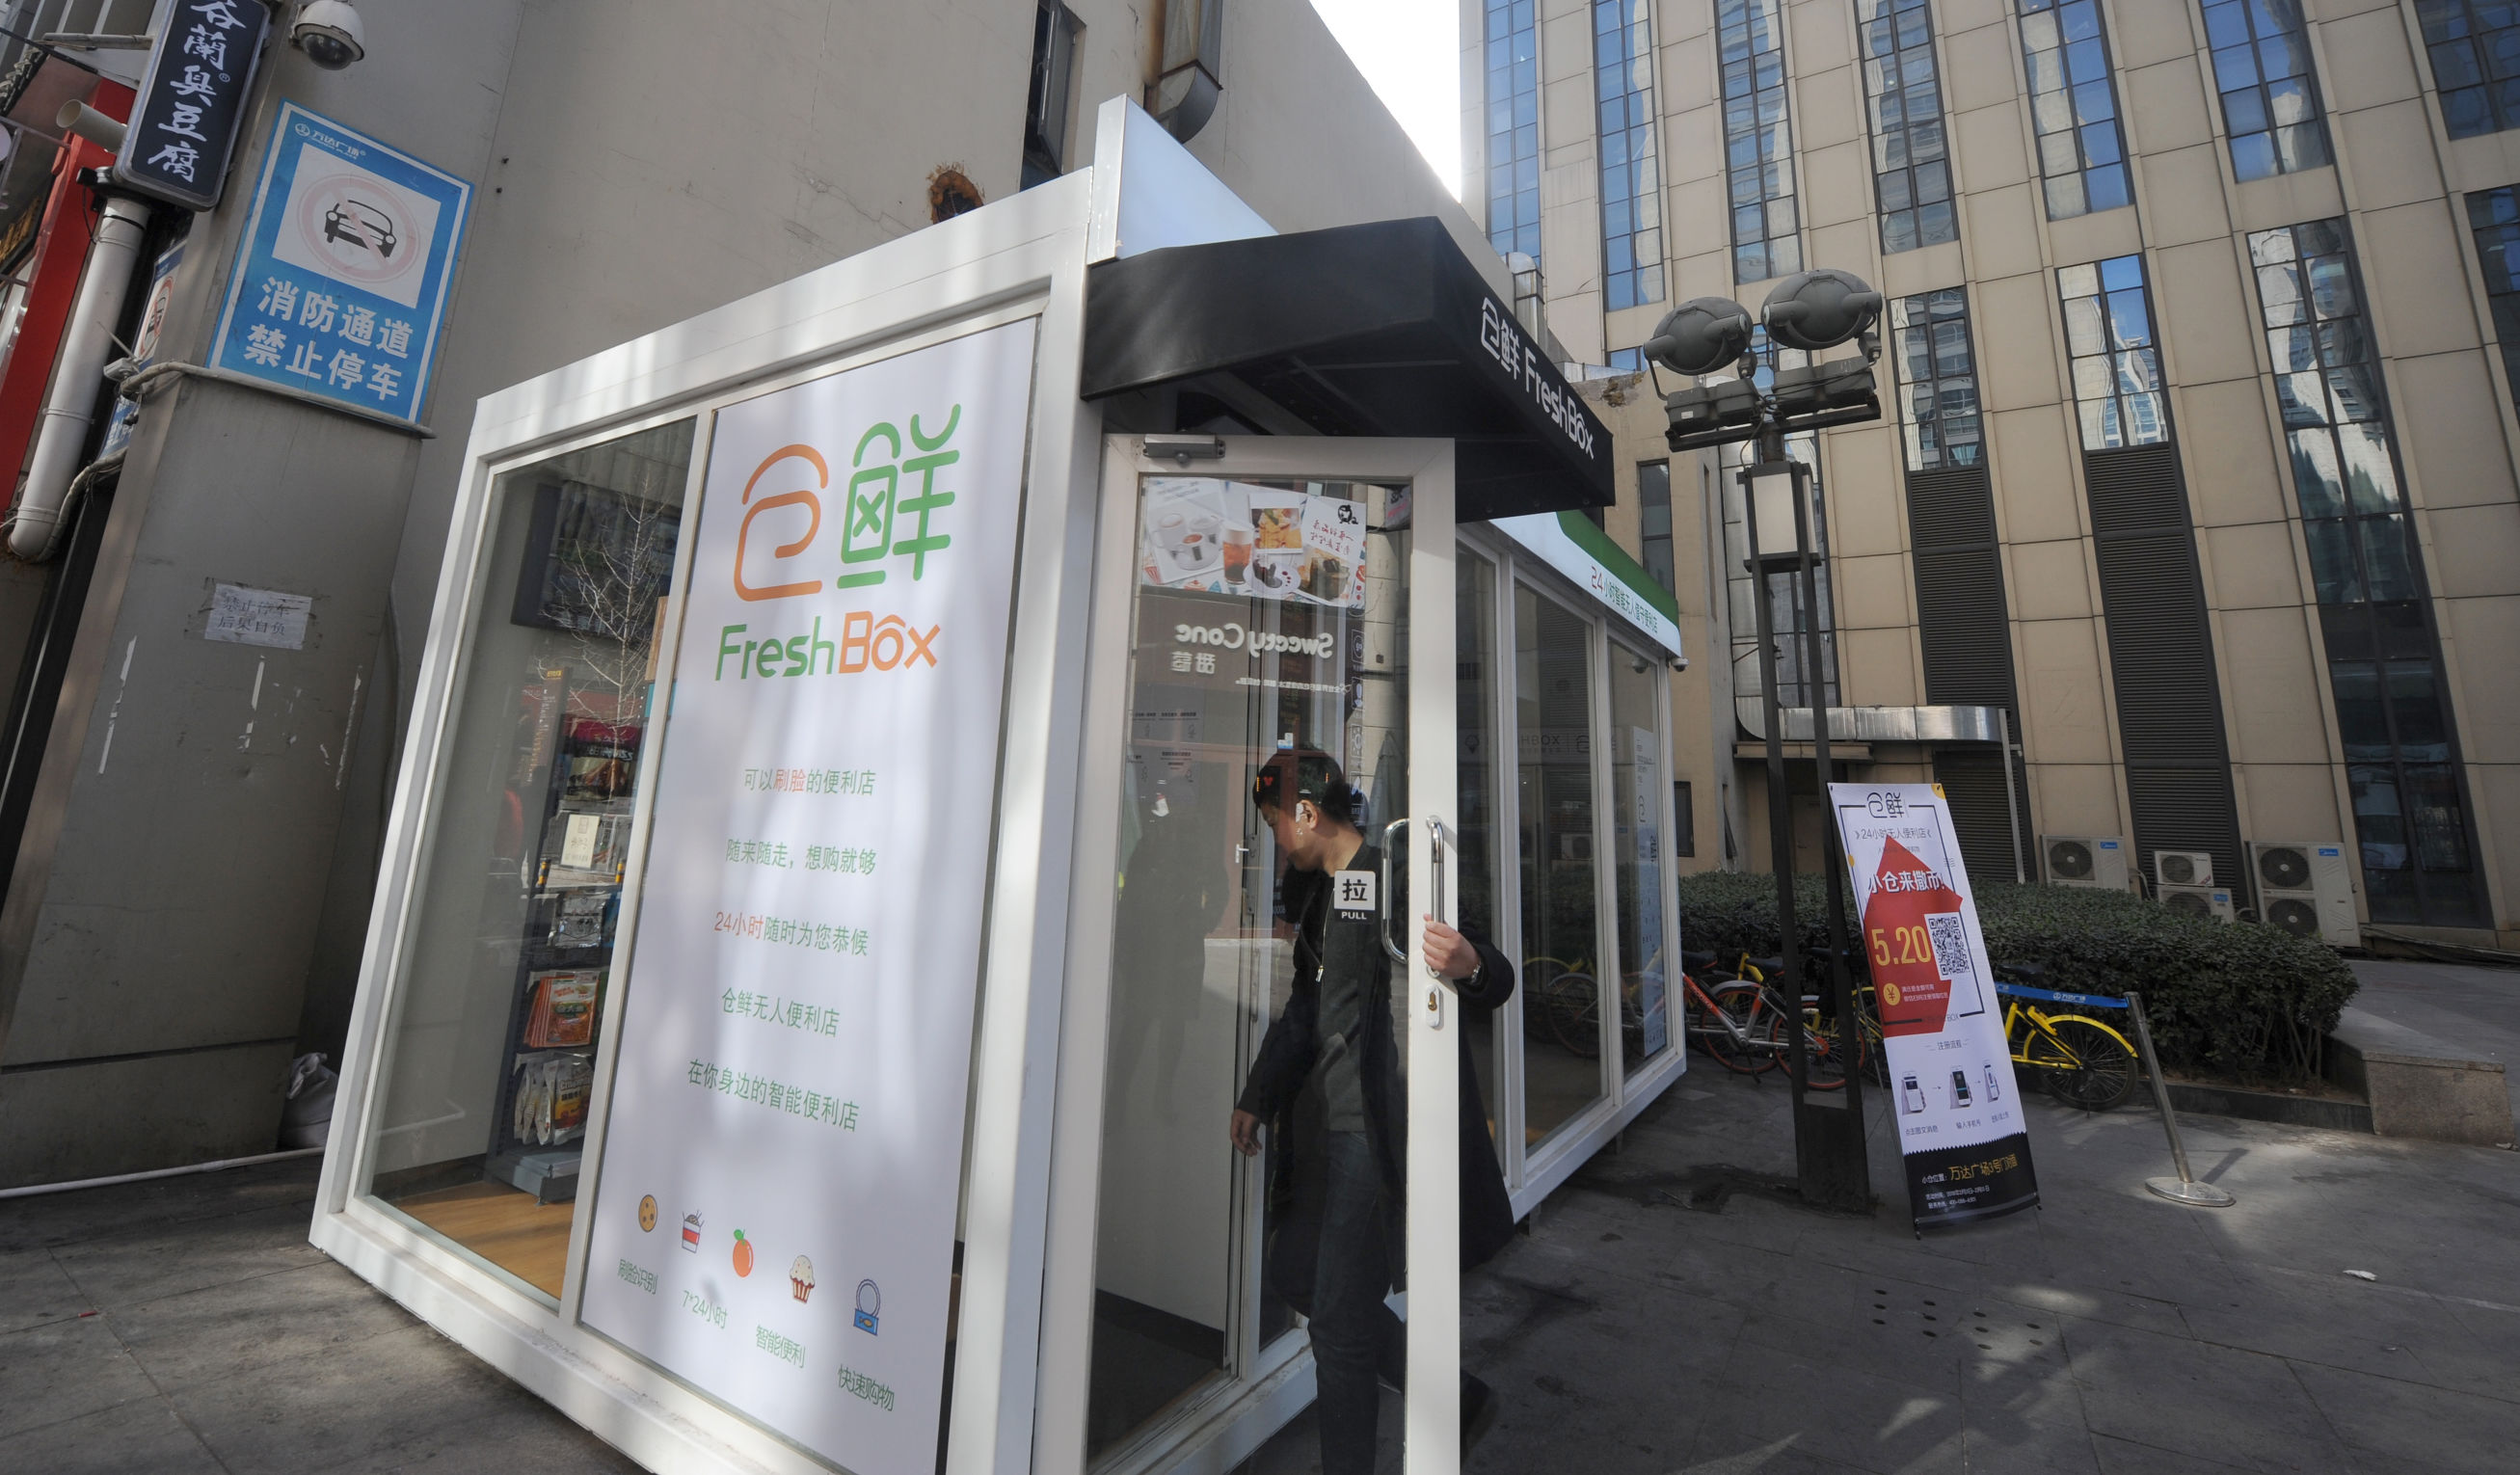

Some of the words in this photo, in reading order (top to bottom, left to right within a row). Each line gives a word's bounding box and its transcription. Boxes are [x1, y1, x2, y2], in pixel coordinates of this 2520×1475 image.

[256, 276, 415, 361] 消防通道
[243, 323, 403, 401] 禁止停车
[1525, 346, 1595, 460] FreshBox
[715, 610, 941, 682] FreshBox
[743, 768, 876, 796] 可以刷脸的便利店
[1342, 878, 1368, 901] 拉
[713, 911, 870, 957] 24小时随时为您恭候
[1341, 910, 1367, 921] PULL
[1871, 925, 1932, 967] 5.20
[721, 986, 841, 1038] 仓鲜无人便利店
[687, 1058, 860, 1133] 在你身边的智能便利店
[755, 1324, 807, 1370] 智能便利
[837, 1364, 896, 1413] 快速购物
